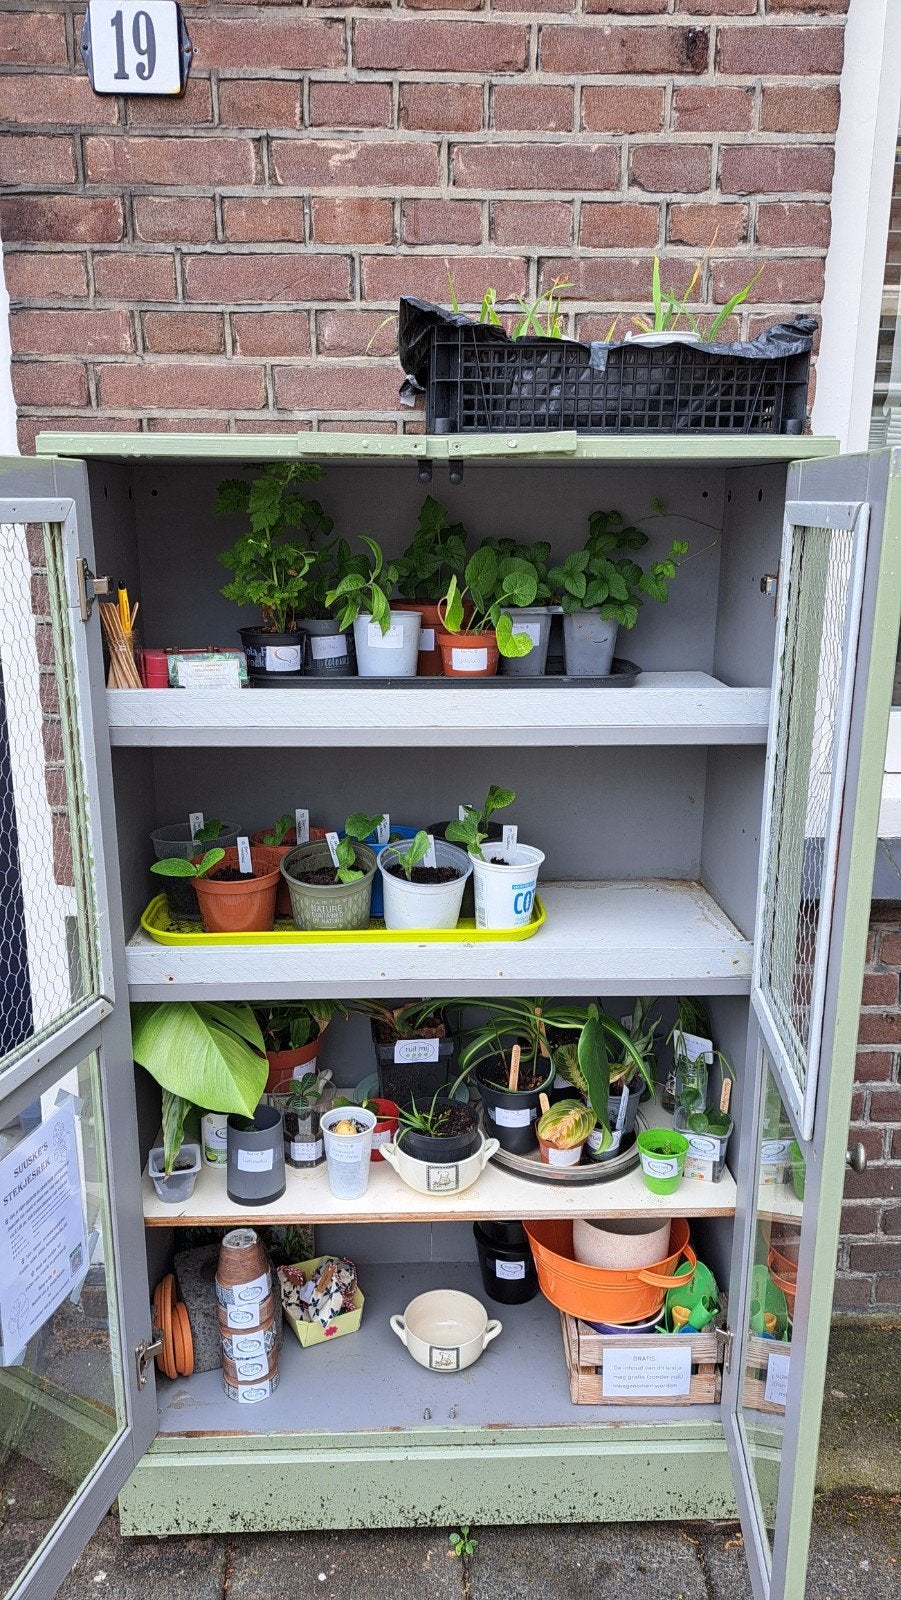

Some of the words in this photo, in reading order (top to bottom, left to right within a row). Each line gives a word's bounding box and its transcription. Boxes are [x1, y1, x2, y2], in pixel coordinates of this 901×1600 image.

[110, 10, 157, 80] 19
[3, 1156, 51, 1206] STEKJESREK
[13, 1141, 49, 1178] SUUSKE'S
